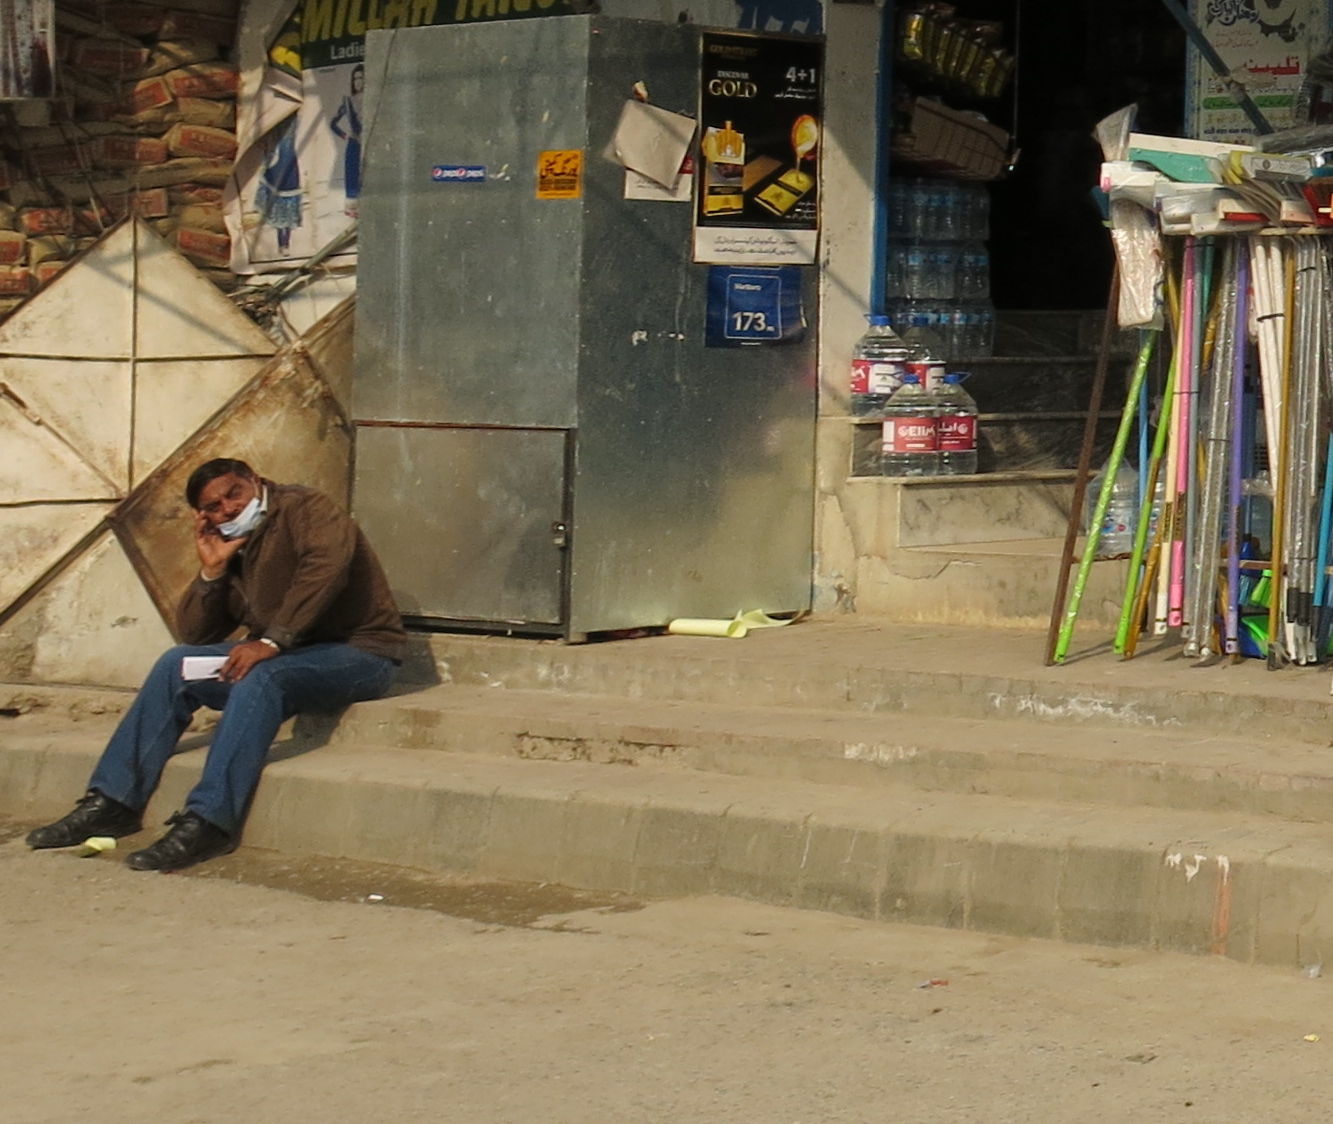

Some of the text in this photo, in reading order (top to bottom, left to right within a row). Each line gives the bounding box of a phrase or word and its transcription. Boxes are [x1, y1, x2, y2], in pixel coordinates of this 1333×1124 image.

[785, 66, 816, 84] 4+1
[708, 79, 758, 98] GOLD
[732, 311, 766, 331] 173
